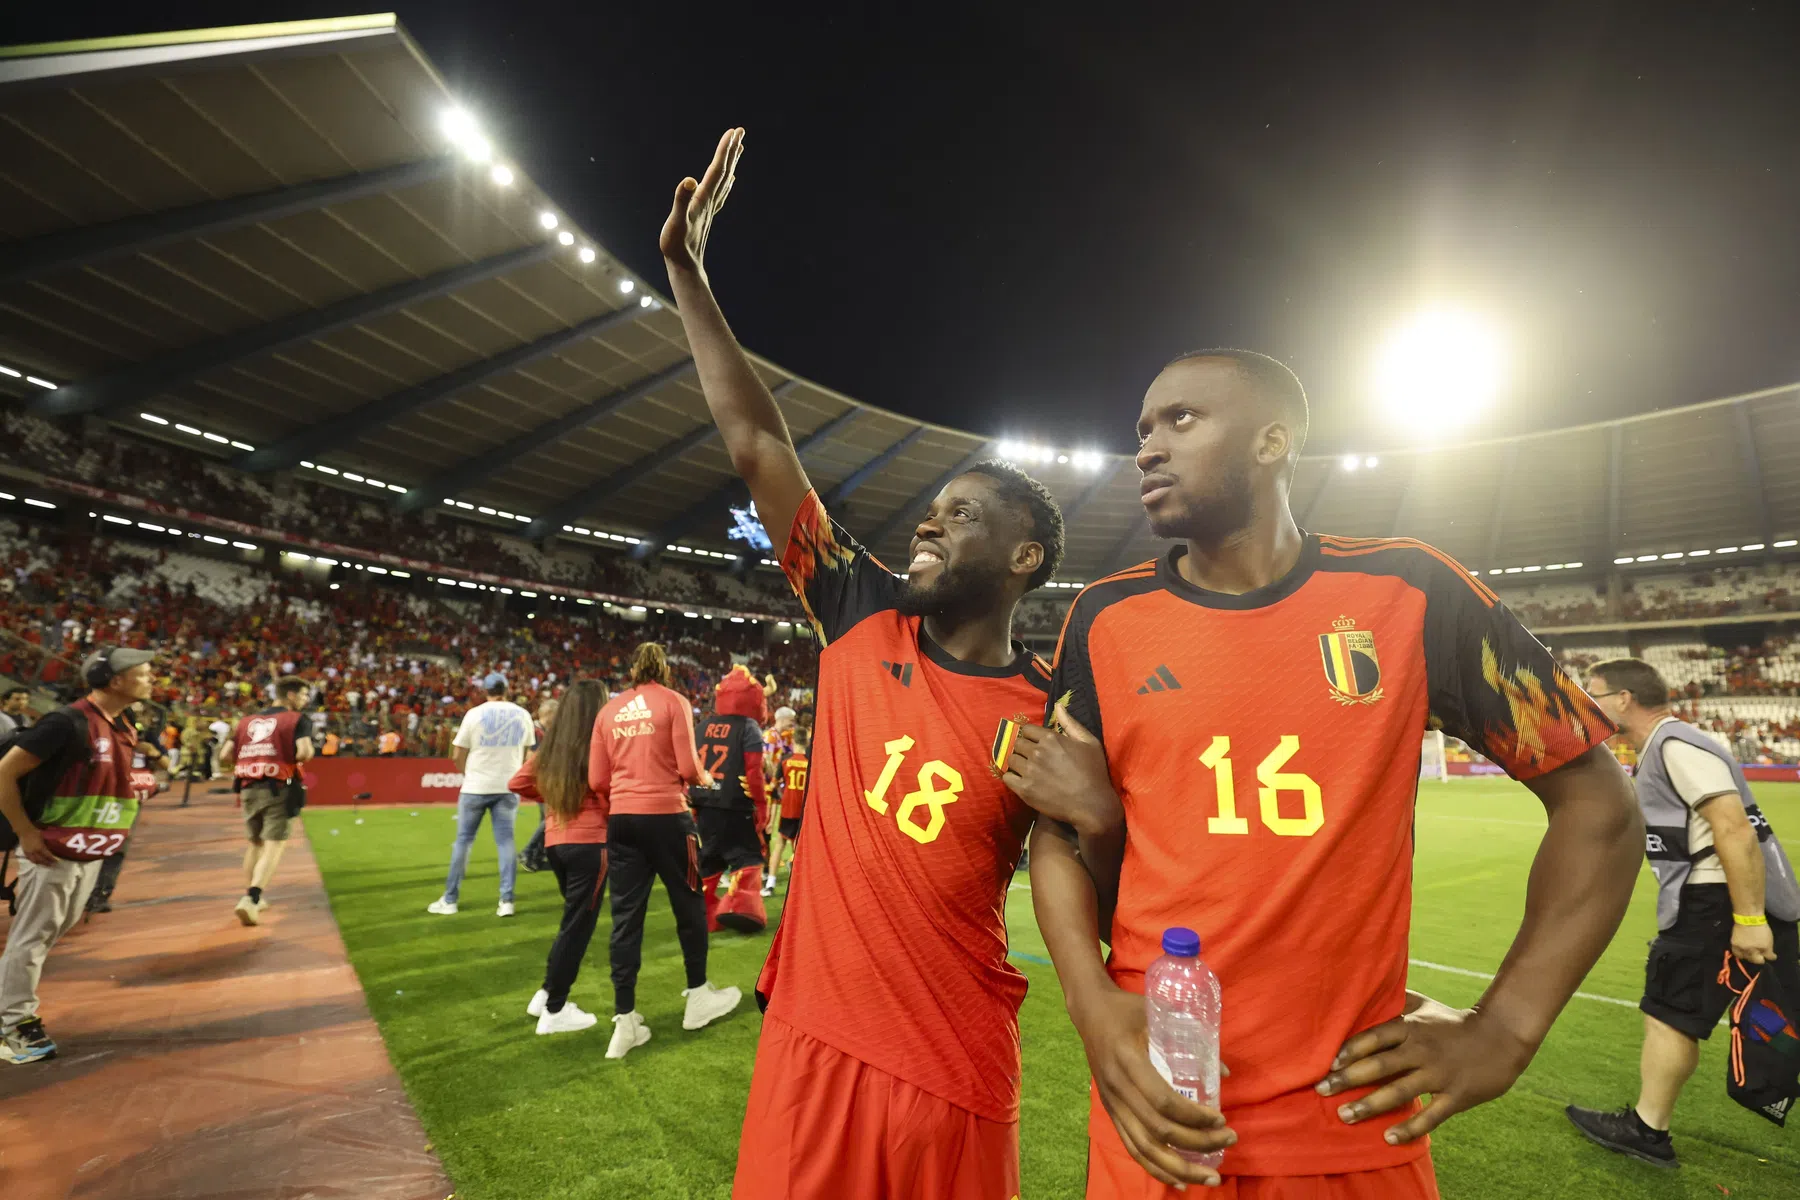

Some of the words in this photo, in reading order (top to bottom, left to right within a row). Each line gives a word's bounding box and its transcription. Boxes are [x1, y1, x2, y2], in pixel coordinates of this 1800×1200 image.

[611, 725, 637, 740] ING
[705, 723, 732, 739] RED
[698, 743, 729, 780] 12
[787, 769, 807, 791] 10
[864, 734, 964, 844] 18
[1198, 734, 1325, 837] 16
[65, 832, 125, 856] 422
